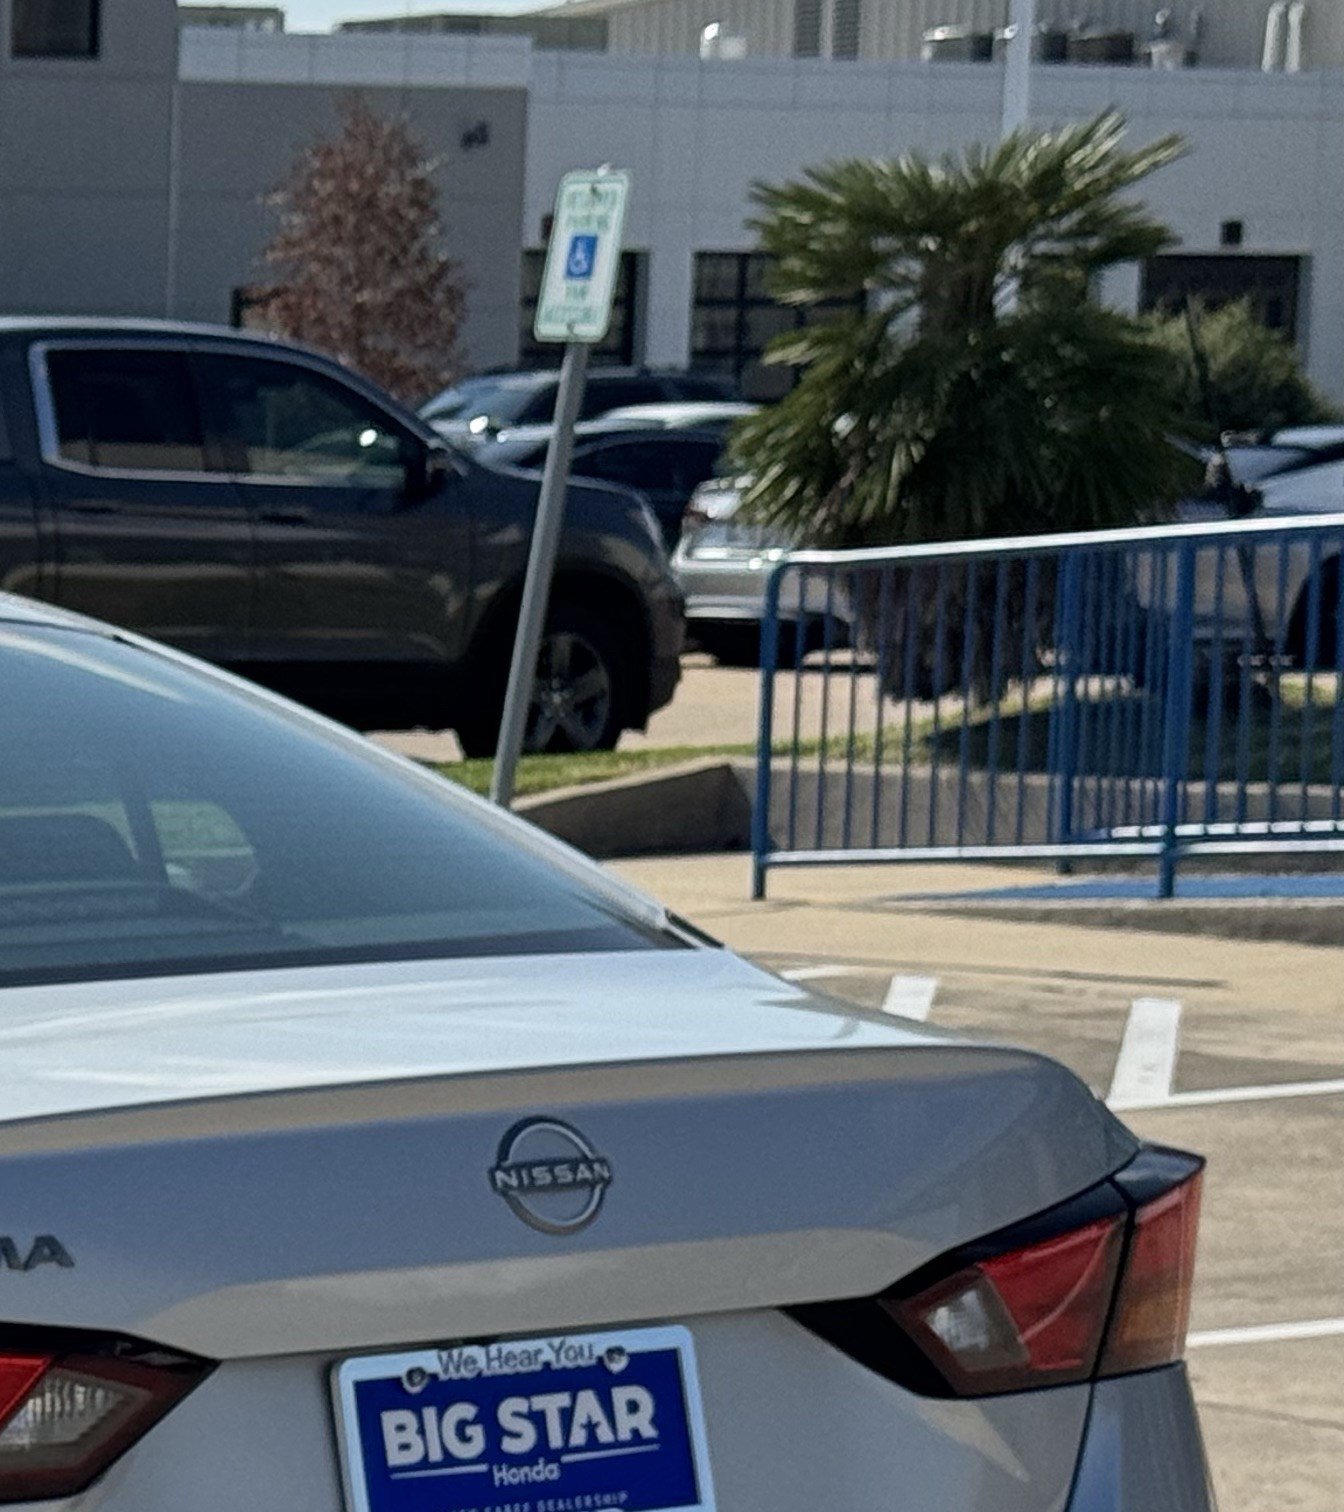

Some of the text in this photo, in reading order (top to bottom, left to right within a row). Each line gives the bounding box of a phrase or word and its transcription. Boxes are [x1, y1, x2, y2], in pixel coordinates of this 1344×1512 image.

[494, 1162, 610, 1188] NISSAN
[437, 1338, 594, 1375] We Hear You
[380, 1384, 659, 1468] BIG STAR
[492, 1457, 561, 1487] Honda
